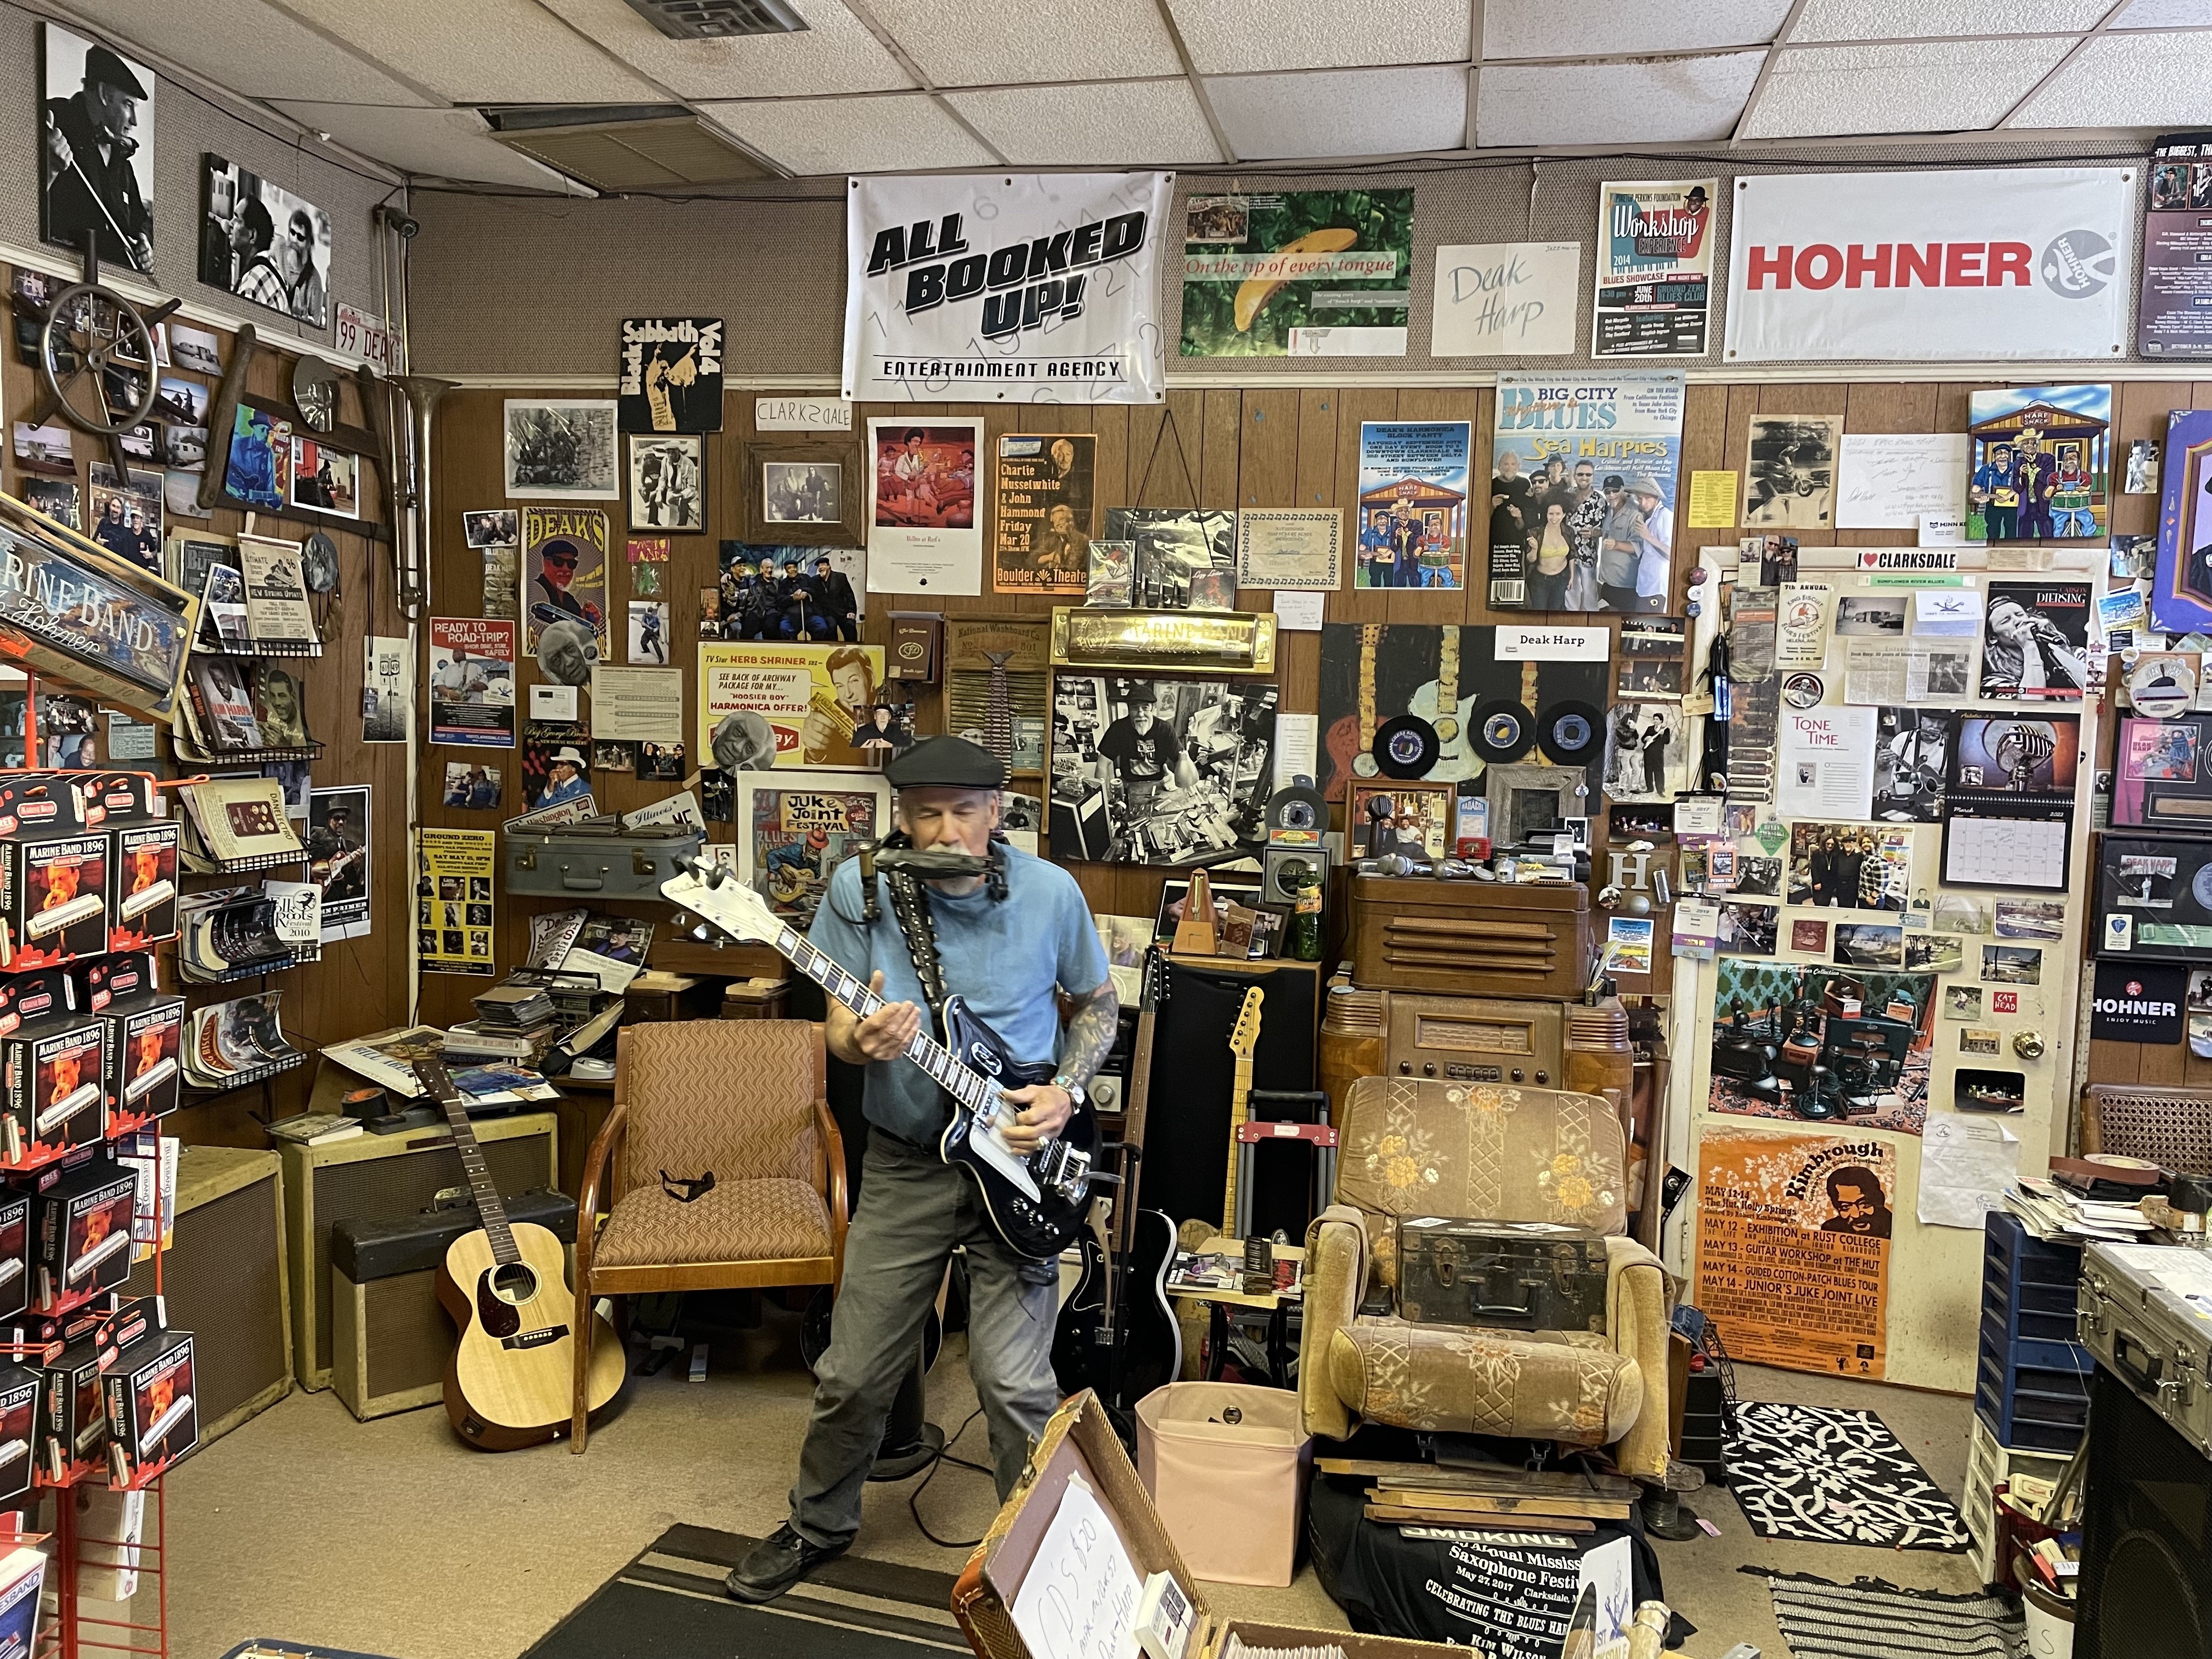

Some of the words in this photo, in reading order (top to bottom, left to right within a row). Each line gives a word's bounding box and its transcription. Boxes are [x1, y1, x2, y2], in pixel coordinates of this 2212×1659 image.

[2156, 148, 2167, 158] THE
[2168, 145, 2197, 158] BIGGEST,
[1654, 193, 1681, 202] FOUNDATION
[1614, 205, 1699, 244] Workshop
[867, 212, 968, 276] ALL
[1638, 238, 1685, 253] EXPERIENCE
[905, 211, 1146, 314] BOOKED
[1186, 259, 1209, 274] On
[1214, 258, 1238, 273] the
[1243, 261, 1265, 277] tip
[1269, 258, 1288, 278] of
[1289, 261, 1334, 275] every
[1338, 259, 1395, 275] tongue
[1613, 255, 1630, 266] 2014
[1747, 241, 2032, 290] HOHNER
[2057, 237, 2091, 289] HOHNER
[1448, 253, 1532, 305] Deak
[1603, 275, 1624, 284] BLUES
[1626, 273, 1664, 283] SHOWCASE
[1657, 285, 1685, 293] GROUND
[1688, 284, 1705, 292] ZERO
[1657, 293, 1682, 302] BLUES
[1684, 292, 1705, 301] CLUB
[981, 273, 1087, 338] UP!
[1634, 294, 1652, 303] 20th
[1474, 292, 1543, 338] Harp
[341, 321, 356, 351] 99
[623, 320, 698, 343] Sabbath
[699, 320, 721, 356] Vol
[621, 343, 642, 395] Black
[699, 357, 720, 375] 4
[884, 362, 1039, 377] ENTERTAINMENT
[1047, 362, 1120, 377] AGENCY
[1538, 388, 1570, 400] BIG
[1575, 388, 1618, 400] CITY
[1499, 388, 1616, 429] BLUES
[1523, 438, 1571, 461] Sea
[1579, 437, 1668, 459] Harpies
[1001, 465, 1035, 476] Charlie
[1001, 478, 1060, 489] Musselwhite
[1001, 494, 1006, 504] &
[1009, 493, 1031, 504] John
[1001, 506, 1046, 517] Hammond
[528, 513, 603, 552] DEAK'S
[1000, 520, 1032, 533] Friday
[1000, 534, 1017, 545] Mar
[1020, 534, 1030, 545] 20
[1858, 553, 1862, 567] I
[1879, 553, 1956, 568] CLARKSDALE
[998, 568, 1034, 582] Boulder
[2036, 592, 2086, 603] DIERSING
[12, 597, 100, 653] Hohner
[78, 582, 153, 652] BAND
[435, 623, 471, 633] READY
[473, 623, 487, 633] TO
[958, 625, 988, 638] National
[989, 623, 1029, 637] Washboard
[1126, 618, 1197, 638] MARINE
[1202, 625, 1249, 641] BAND
[448, 632, 509, 643] ROAD-TRIP?
[1520, 635, 1550, 645] Deak
[1553, 635, 1585, 647] Harp
[760, 656, 806, 665] SHRINER
[710, 702, 770, 710] HARMONICA
[774, 704, 808, 712] OFFER!
[1792, 716, 1831, 731] TONE
[1806, 731, 1838, 744] TIME
[88, 807, 103, 818] FREE
[629, 804, 672, 825] Illinois
[792, 808, 844, 820] Joint
[1462, 803, 1484, 811] HADACOL
[269, 793, 295, 841] DANELECTRO
[30, 845, 60, 859] MARINE
[61, 843, 82, 855] BAND
[83, 840, 104, 852] 1896
[93, 990, 108, 1003] FREE
[1997, 994, 2015, 1003] CAT
[1994, 1001, 2016, 1011] HEAD
[39, 1041, 65, 1056] MARINE
[65, 1035, 82, 1048] BAND
[83, 1029, 100, 1043] 1896
[1786, 1142, 1883, 1201] Kimbrough
[1705, 1218, 1725, 1230] MAY
[1728, 1221, 1737, 1231] 12
[1747, 1223, 1798, 1238] EXHIBITION
[1813, 1231, 1837, 1243] RUST
[1839, 1234, 1881, 1249] COLLEGE
[1704, 1240, 1725, 1250] MAY
[1729, 1242, 1737, 1252] 13
[1746, 1244, 1777, 1257] GUITAR
[1779, 1247, 1831, 1262] WORKSHOP
[1844, 1256, 1861, 1267] THE
[1863, 1259, 1880, 1271] HUT
[1703, 1261, 1725, 1272] MAY
[1728, 1264, 1737, 1273] 14
[1745, 1266, 1771, 1277] GUIDED
[1774, 1268, 1832, 1285] COTTON-PATCH
[1833, 1277, 1856, 1289] BLUES
[1858, 1280, 1878, 1293] TOUR
[1702, 1274, 1725, 1286] MAY
[1727, 1277, 1736, 1288] 14
[1743, 1279, 1792, 1295] JUNIOR'S
[1794, 1285, 1820, 1298] JUKE
[1821, 1289, 1853, 1303] JOINT
[1855, 1294, 1878, 1307] LIVE
[137, 1365, 158, 1385] MARINE
[158, 1356, 174, 1371] BAND
[174, 1345, 190, 1362] 1896
[1070, 1518, 1096, 1572] $20
[1449, 1545, 1536, 1584] Saxophone
[1455, 1565, 1477, 1583] May
[1477, 1575, 1491, 1587] 27,
[1492, 1579, 1514, 1592] 2017
[1523, 1587, 1570, 1605] Clarksdale,
[1425, 1579, 1489, 1618] CELEBRATING
[1494, 1607, 1514, 1625] THE
[1517, 1614, 1546, 1634] BLUES
[1471, 1634, 1497, 1649] KIM
[1501, 1641, 1547, 1659] WILSON
